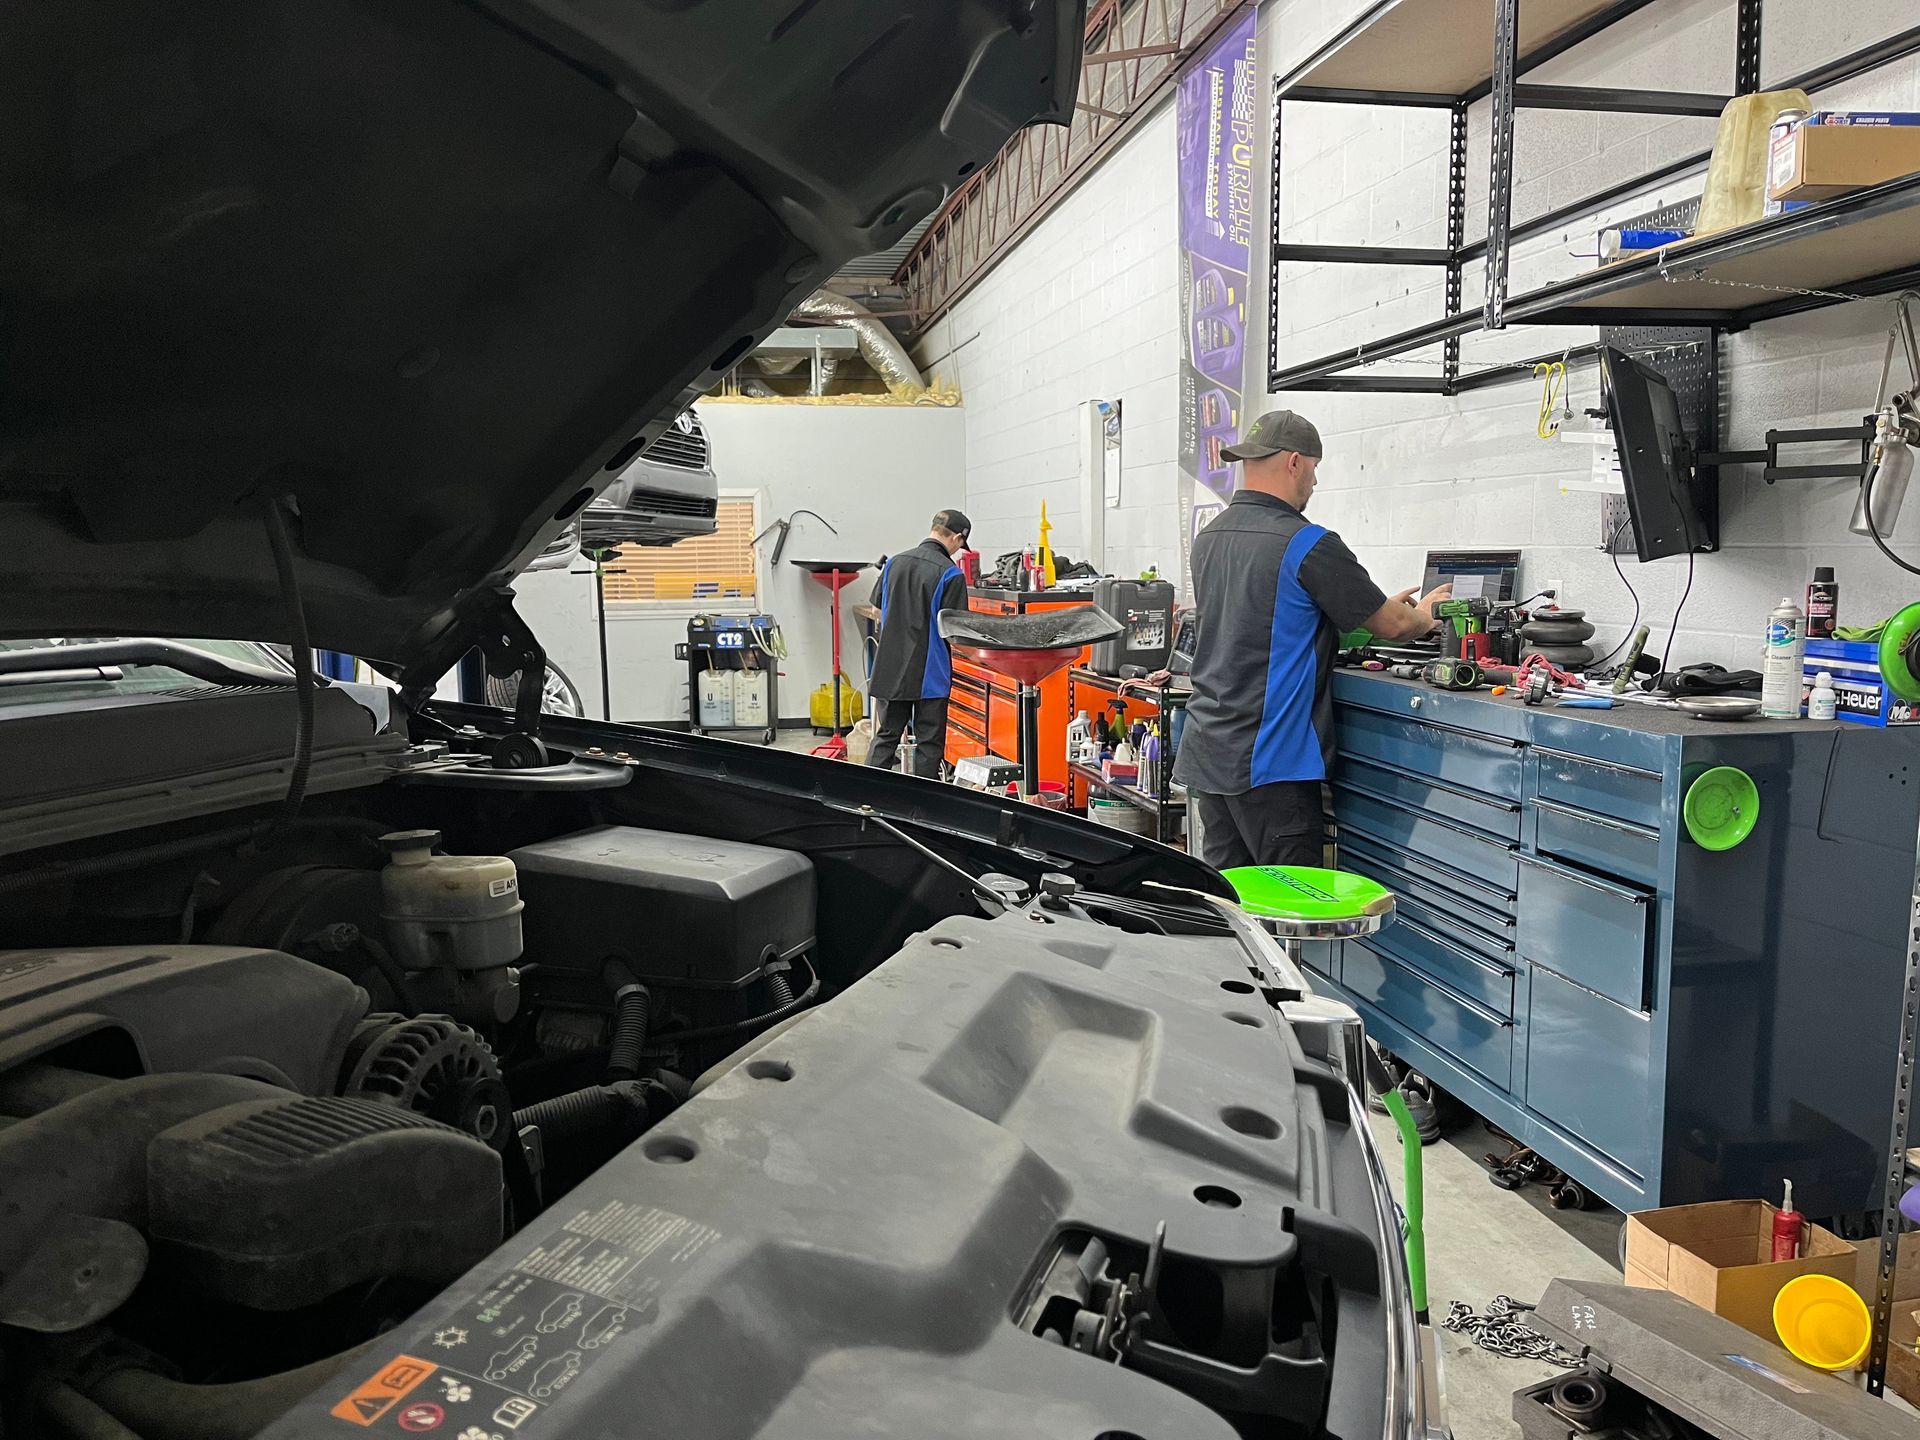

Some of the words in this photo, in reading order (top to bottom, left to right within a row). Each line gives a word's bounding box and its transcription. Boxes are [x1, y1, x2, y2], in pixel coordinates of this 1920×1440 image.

[1214, 72, 1224, 157] UPGRADE
[1212, 163, 1220, 220] TODAY
[1226, 162, 1236, 221] SYNTHETIC
[1231, 119, 1253, 248] PURPLE
[1228, 223, 1236, 244] OIL
[1184, 376, 1192, 424] MOTOR
[1189, 377, 1197, 404] HIGH
[1183, 433, 1191, 454] OIL
[1188, 406, 1197, 455] MILEAGE
[1185, 581, 1193, 599] OIL
[717, 633, 743, 645] CT2
[708, 693, 713, 701] U
[1841, 691, 1881, 709] Heuer
